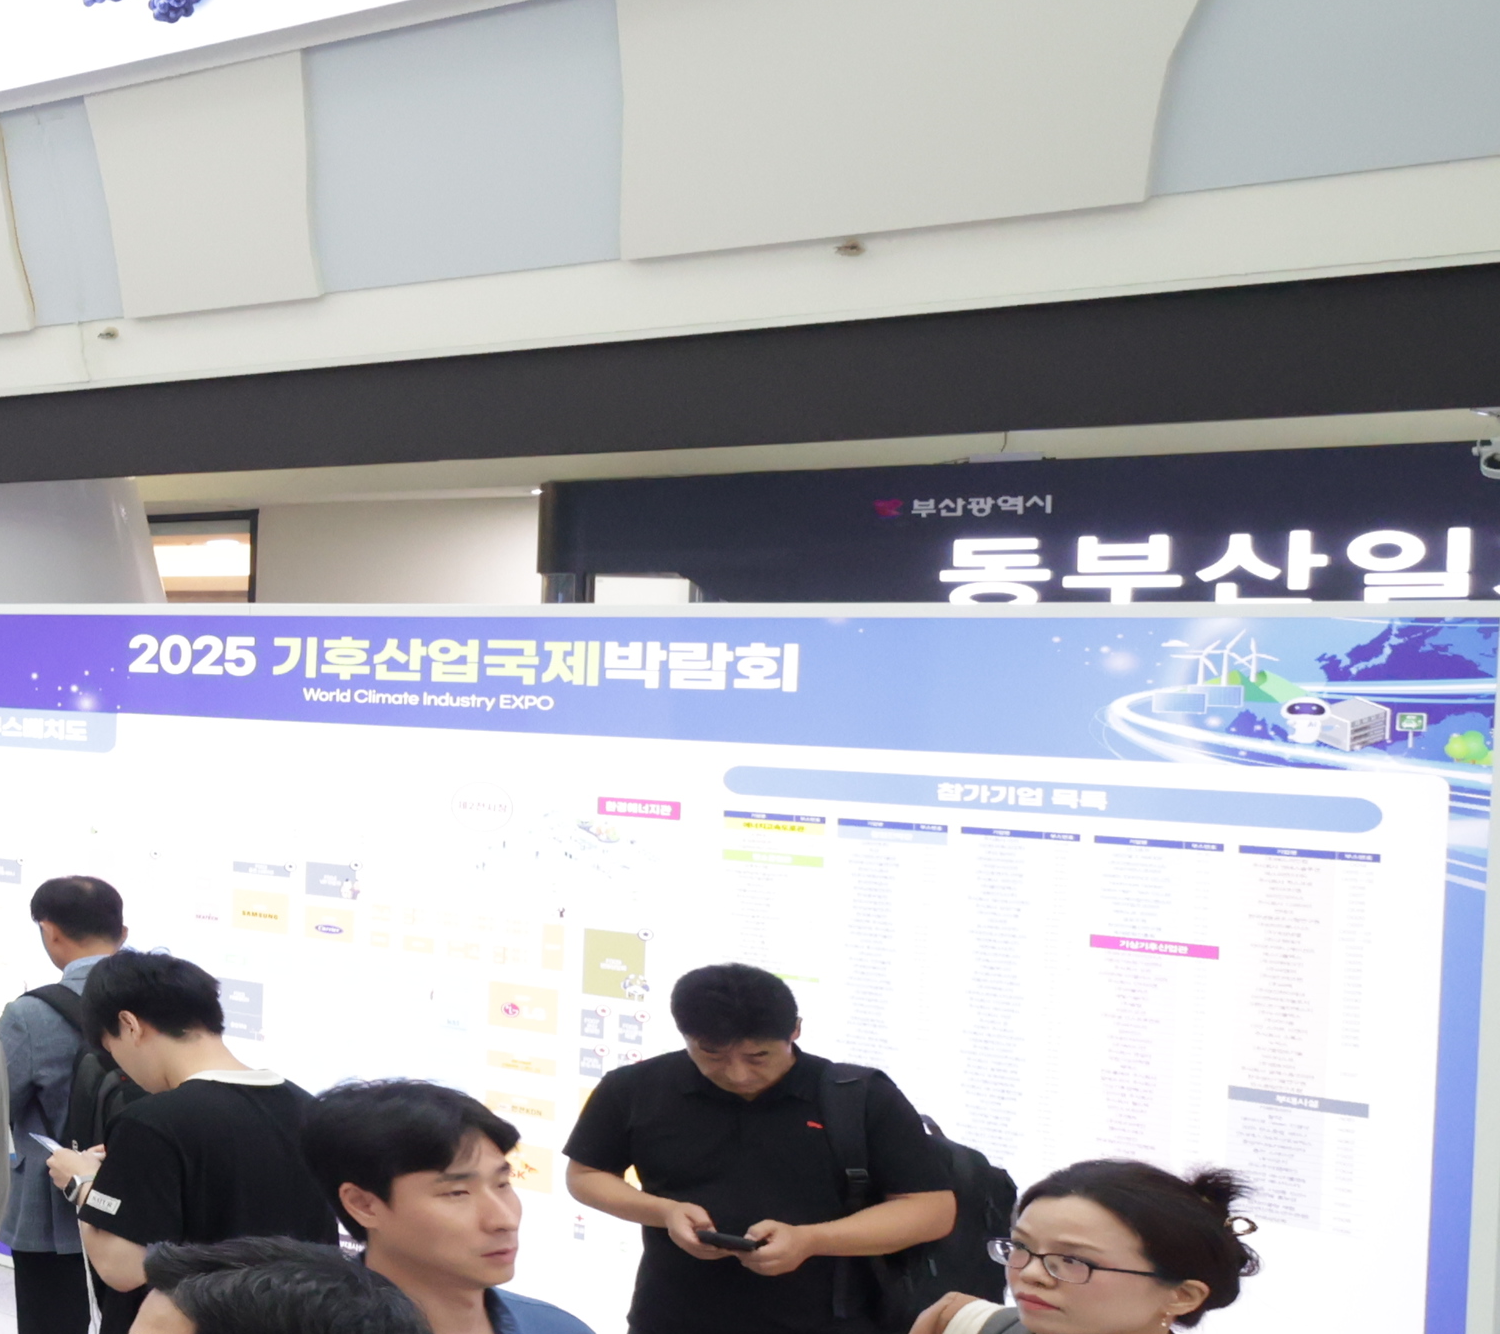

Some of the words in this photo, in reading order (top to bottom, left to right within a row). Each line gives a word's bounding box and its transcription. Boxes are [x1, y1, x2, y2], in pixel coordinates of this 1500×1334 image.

[910, 493, 1054, 518] 부산광역시
[128, 632, 257, 677] 2025
[271, 637, 800, 693] 기후산업국제박람회
[303, 687, 349, 706] World
[352, 687, 419, 707] Climate
[423, 690, 496, 713] Industry
[499, 693, 554, 711] EXPO
[936, 780, 1044, 810] 참가기업
[1050, 787, 1109, 813] 목록
[604, 799, 673, 818] 환경에너지관
[241, 910, 279, 921] SAMSUNG
[316, 924, 342, 934] Carrier
[1119, 938, 1191, 955] 기상기후산업관
